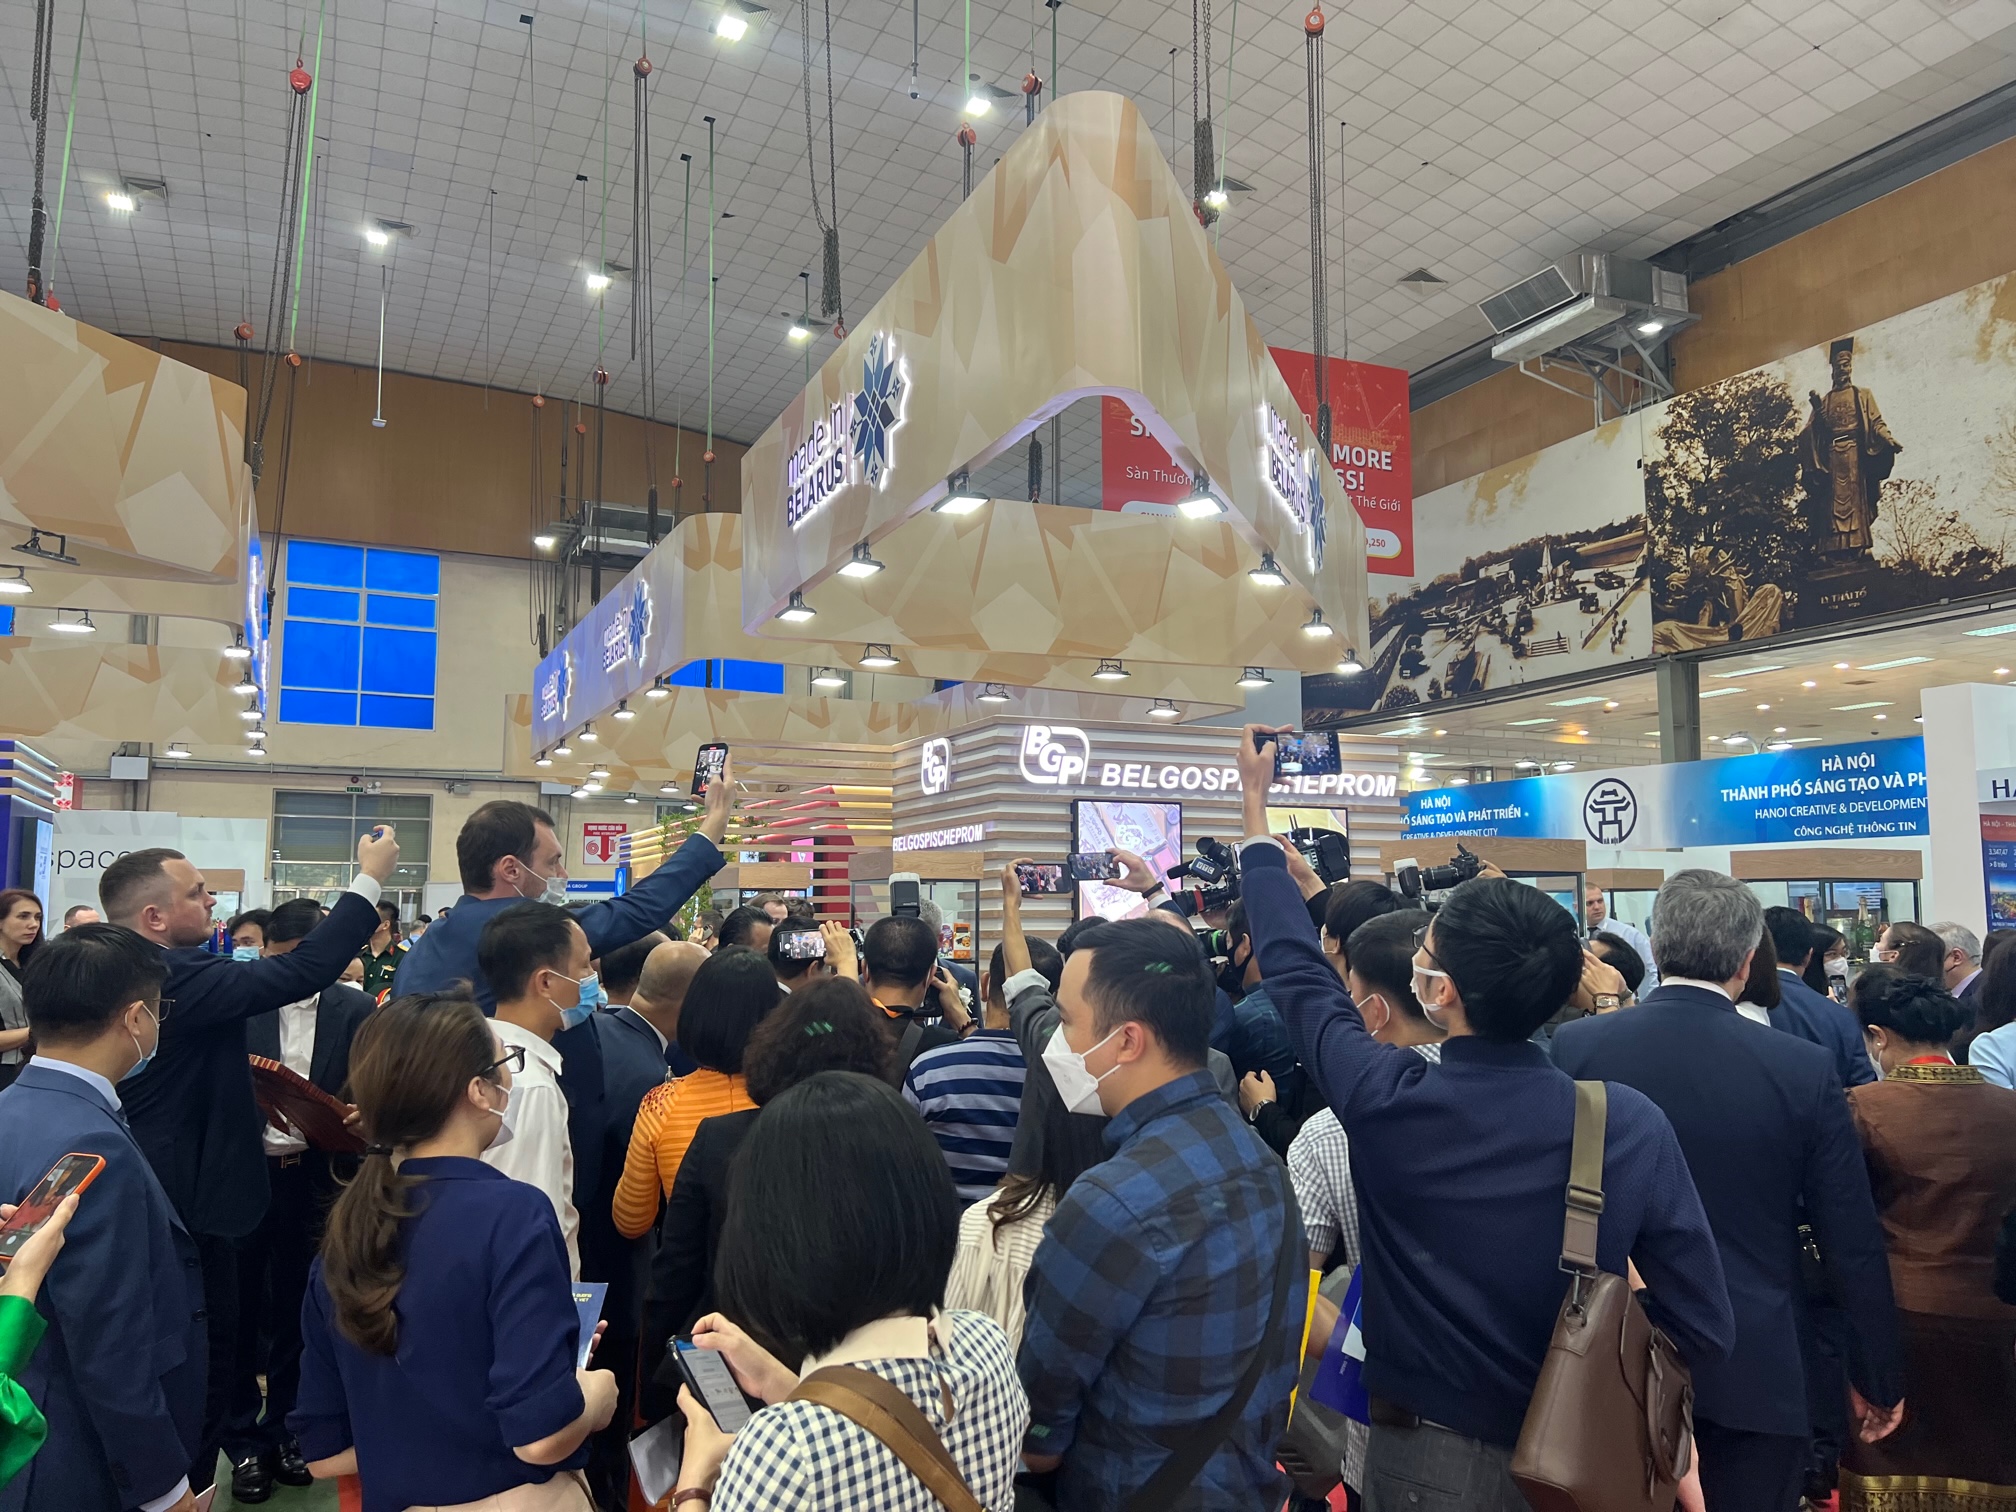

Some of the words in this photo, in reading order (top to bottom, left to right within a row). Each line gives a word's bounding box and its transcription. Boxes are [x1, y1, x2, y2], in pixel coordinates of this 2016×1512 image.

[788, 421, 824, 486] made
[830, 403, 843, 441] in
[1333, 444, 1392, 470] MORE
[1126, 466, 1149, 480] Sàn
[787, 447, 843, 527] BELARUS
[1356, 495, 1377, 509] Thế
[1380, 499, 1401, 512] Giới
[1025, 725, 1084, 784] BGP
[1822, 755, 1844, 772] HÀ
[1847, 752, 1875, 772] NỘI
[1100, 763, 1396, 797] BELGOSPHEPROM
[1721, 784, 1768, 802] THÀNH
[1771, 778, 1802, 798] PHỐ
[1804, 775, 1846, 795] SÁNG
[1848, 776, 1880, 795] TẠO
[1882, 772, 1904, 789] VÀ
[1421, 797, 1433, 809] HÀ
[1434, 795, 1451, 810] NỘI
[1755, 807, 1788, 819] HANOI
[1790, 803, 1837, 817] CREATIVE
[1839, 803, 1847, 814] &
[1411, 813, 1434, 826] SÁNG
[1435, 812, 1453, 827] TẠO
[1454, 810, 1466, 823] VÀ
[1468, 807, 1492, 821] PHÁT
[1493, 803, 1521, 819] TRIỂN
[892, 824, 983, 851] BELGOSPISCHEPROM
[1483, 828, 1499, 837] CITY
[1794, 824, 1822, 837] CÔNG
[1824, 823, 1854, 836] NGHỆ
[1857, 821, 1895, 834] THÔNG
[1898, 822, 1917, 832] TIN
